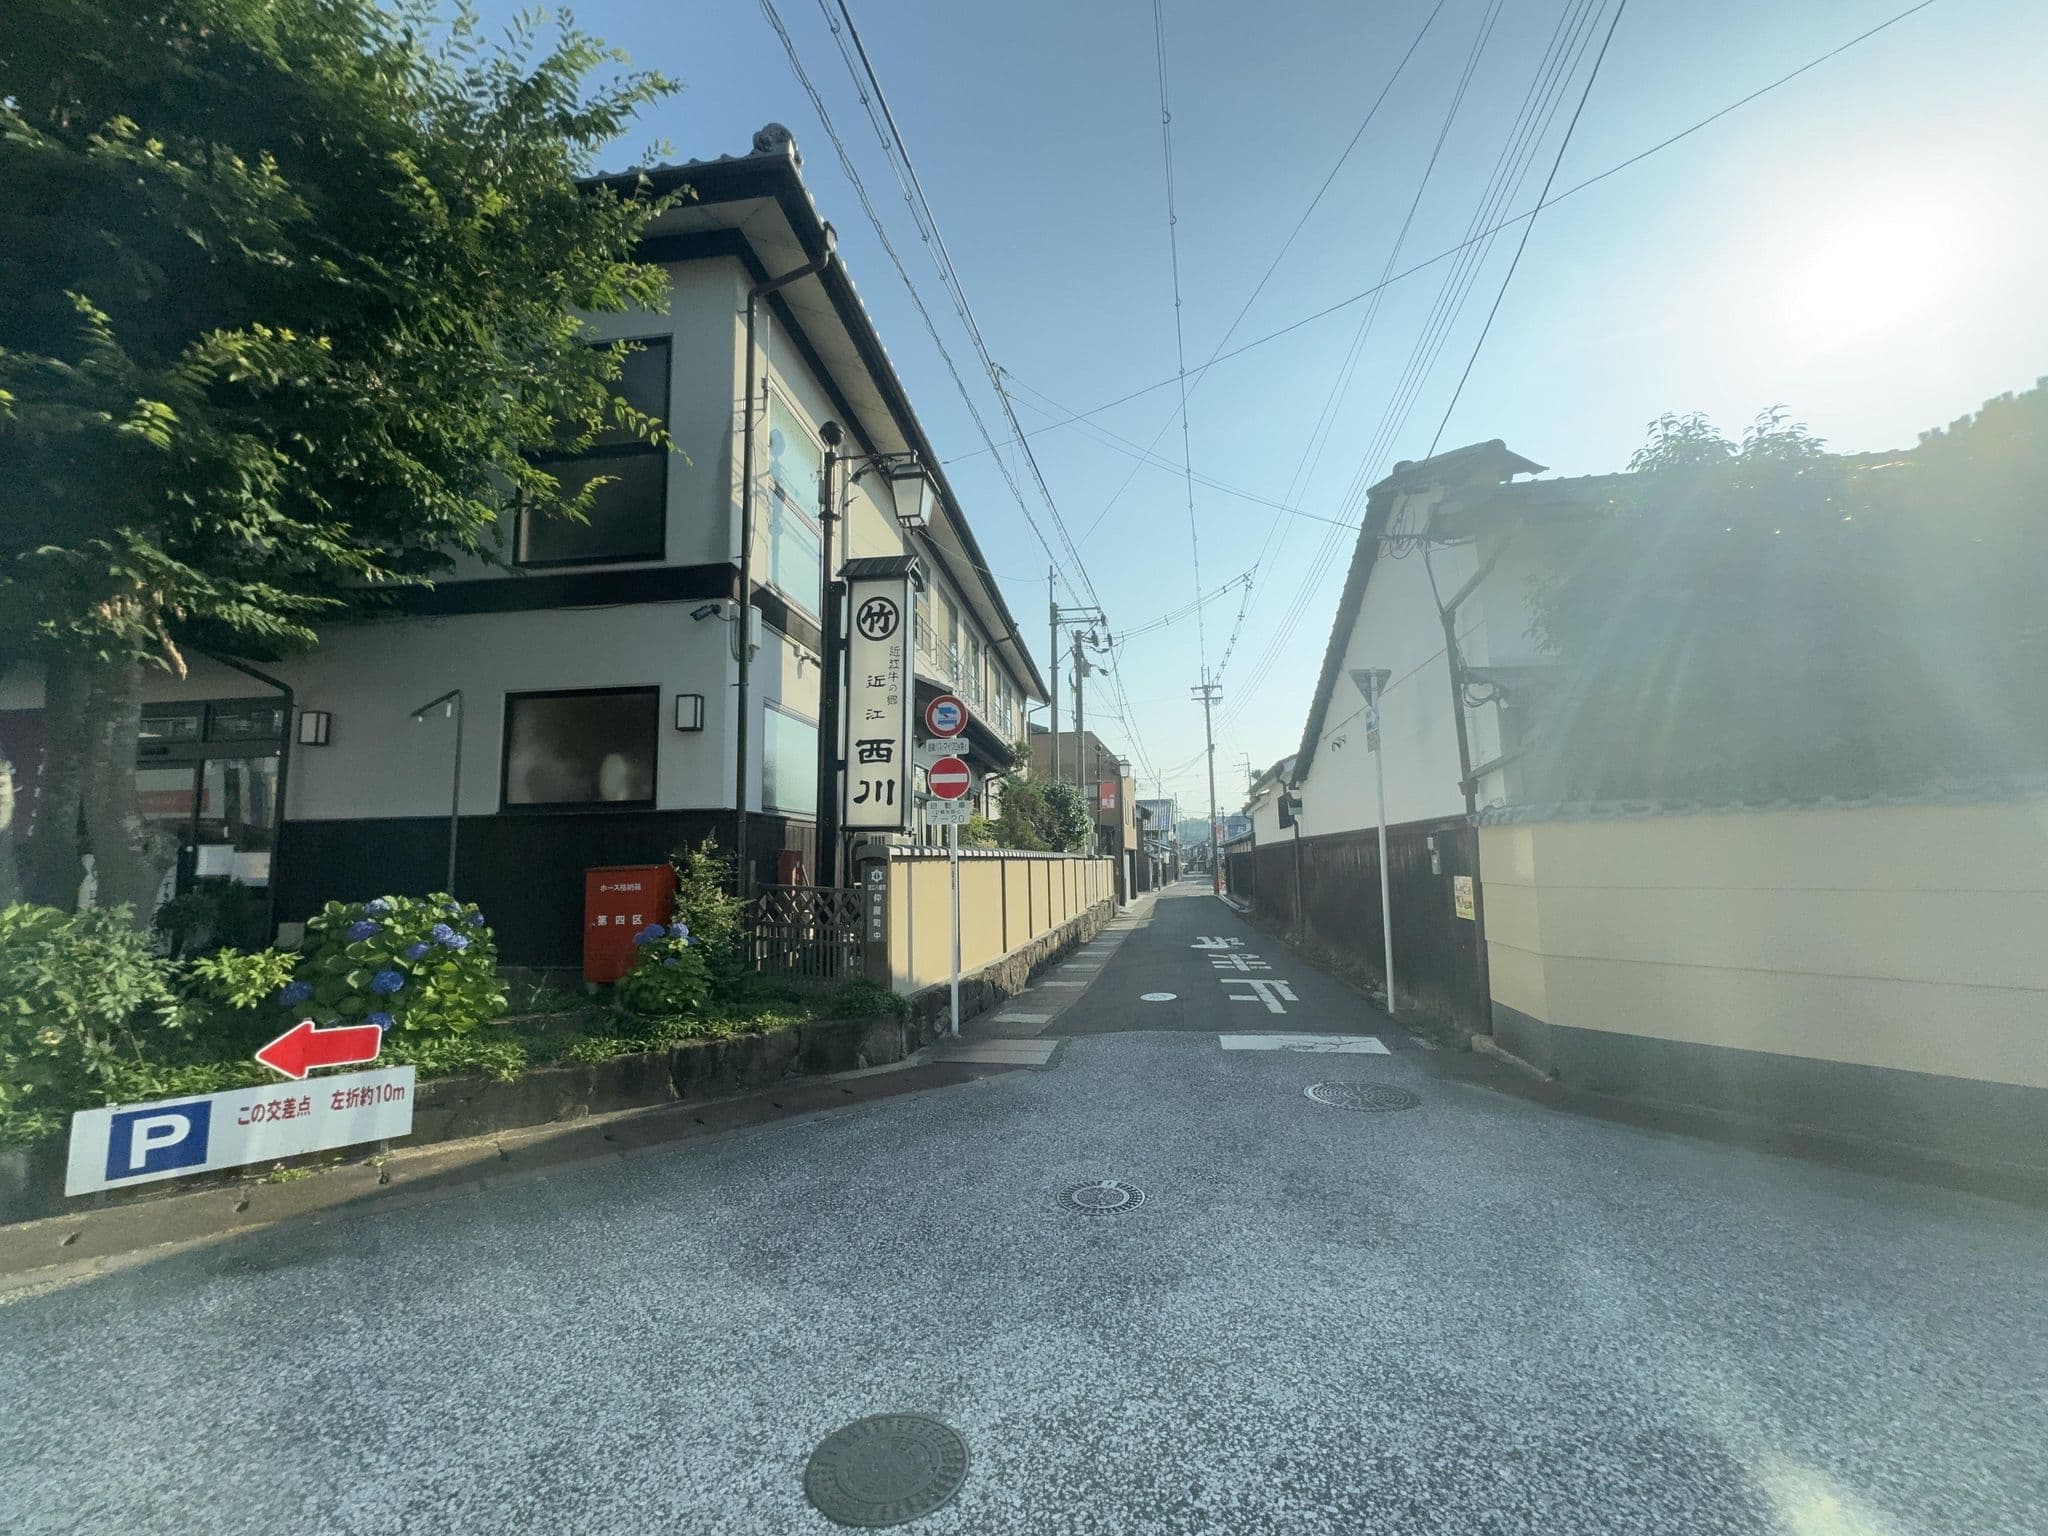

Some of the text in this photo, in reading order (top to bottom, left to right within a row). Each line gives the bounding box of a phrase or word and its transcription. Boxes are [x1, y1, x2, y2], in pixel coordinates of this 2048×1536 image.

[861, 602, 894, 634] 竹
[853, 674, 896, 806] 近江西川
[599, 883, 642, 892] ホース格納箱
[597, 914, 643, 926] 第四区
[237, 1083, 406, 1126] この交差点 左折約10m
[128, 1114, 191, 1170] P
